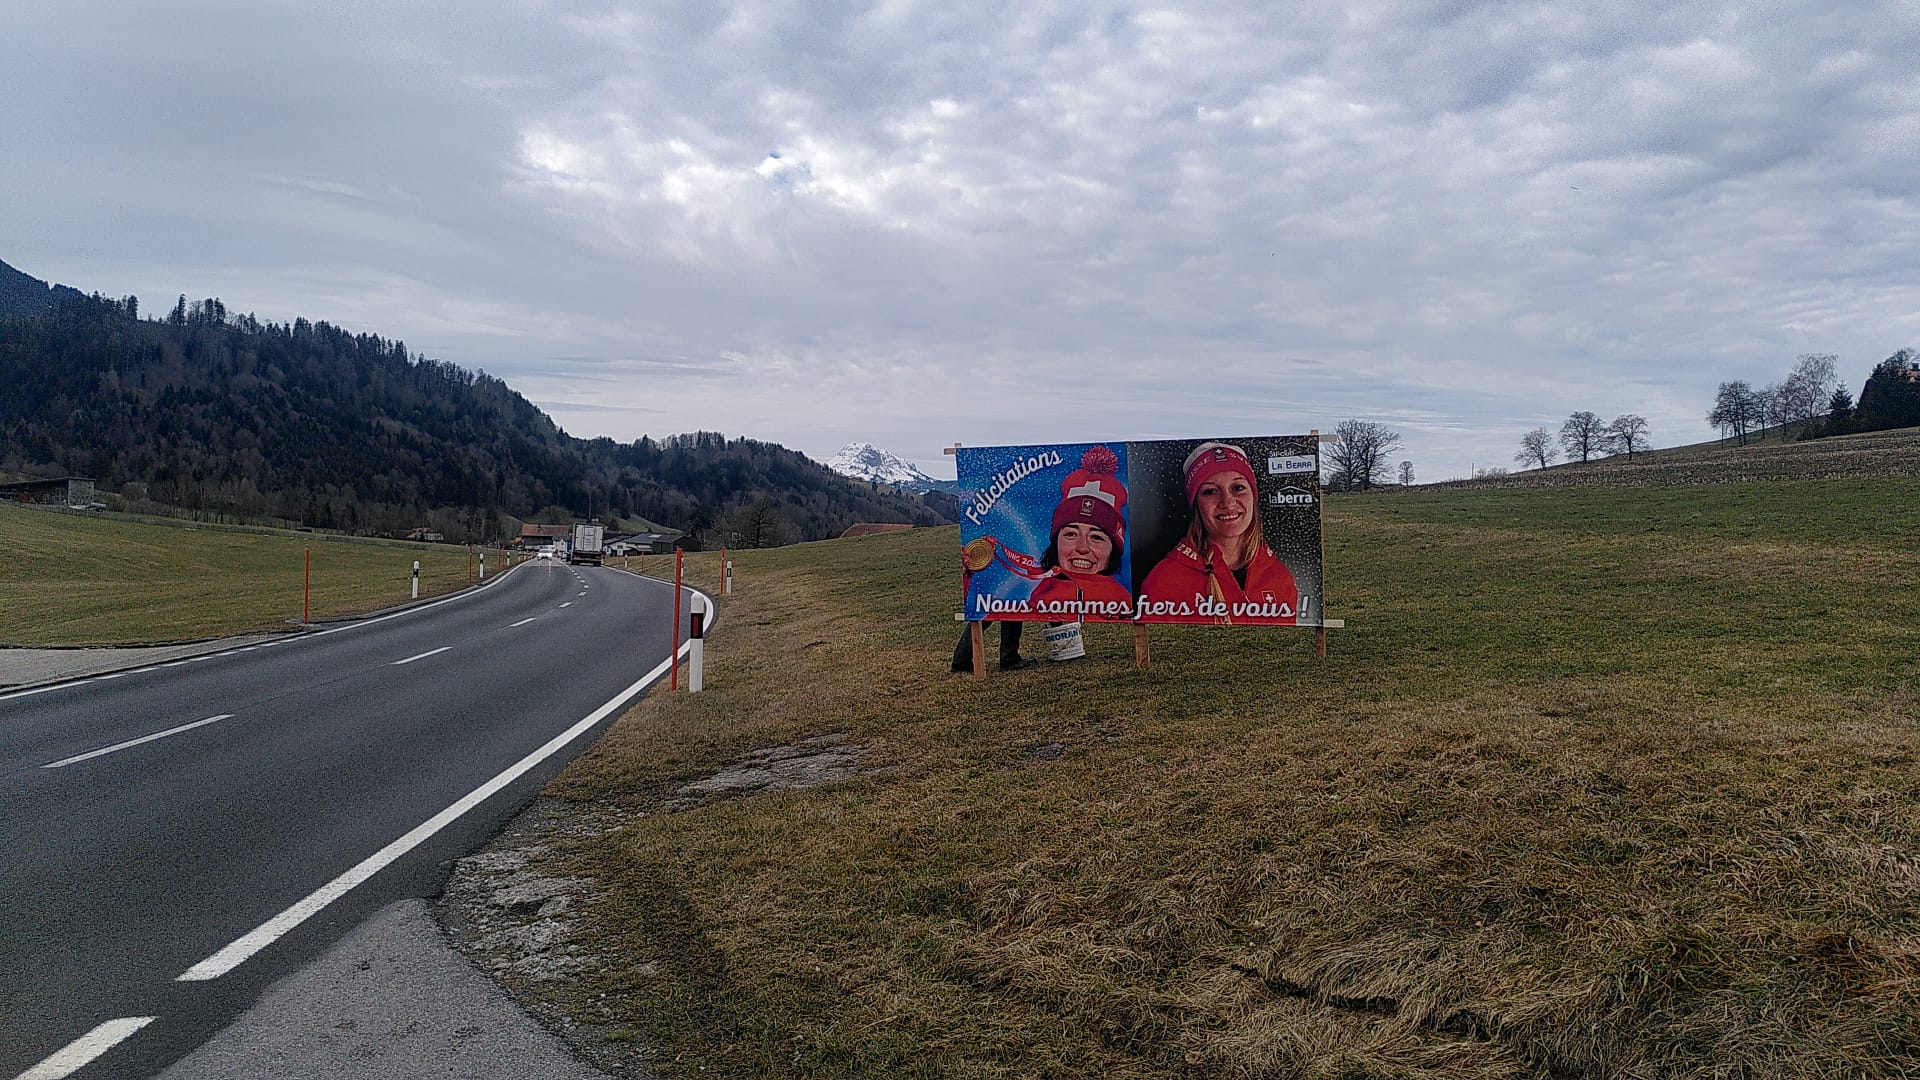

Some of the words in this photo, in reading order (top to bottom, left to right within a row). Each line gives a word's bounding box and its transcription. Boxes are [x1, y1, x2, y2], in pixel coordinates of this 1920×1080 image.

[965, 449, 1064, 526] Félicitations
[975, 593, 1032, 613] Nous
[1036, 599, 1134, 615] sommes
[1131, 594, 1194, 621] fiers
[1197, 594, 1229, 617] de
[1232, 601, 1296, 618] vous
